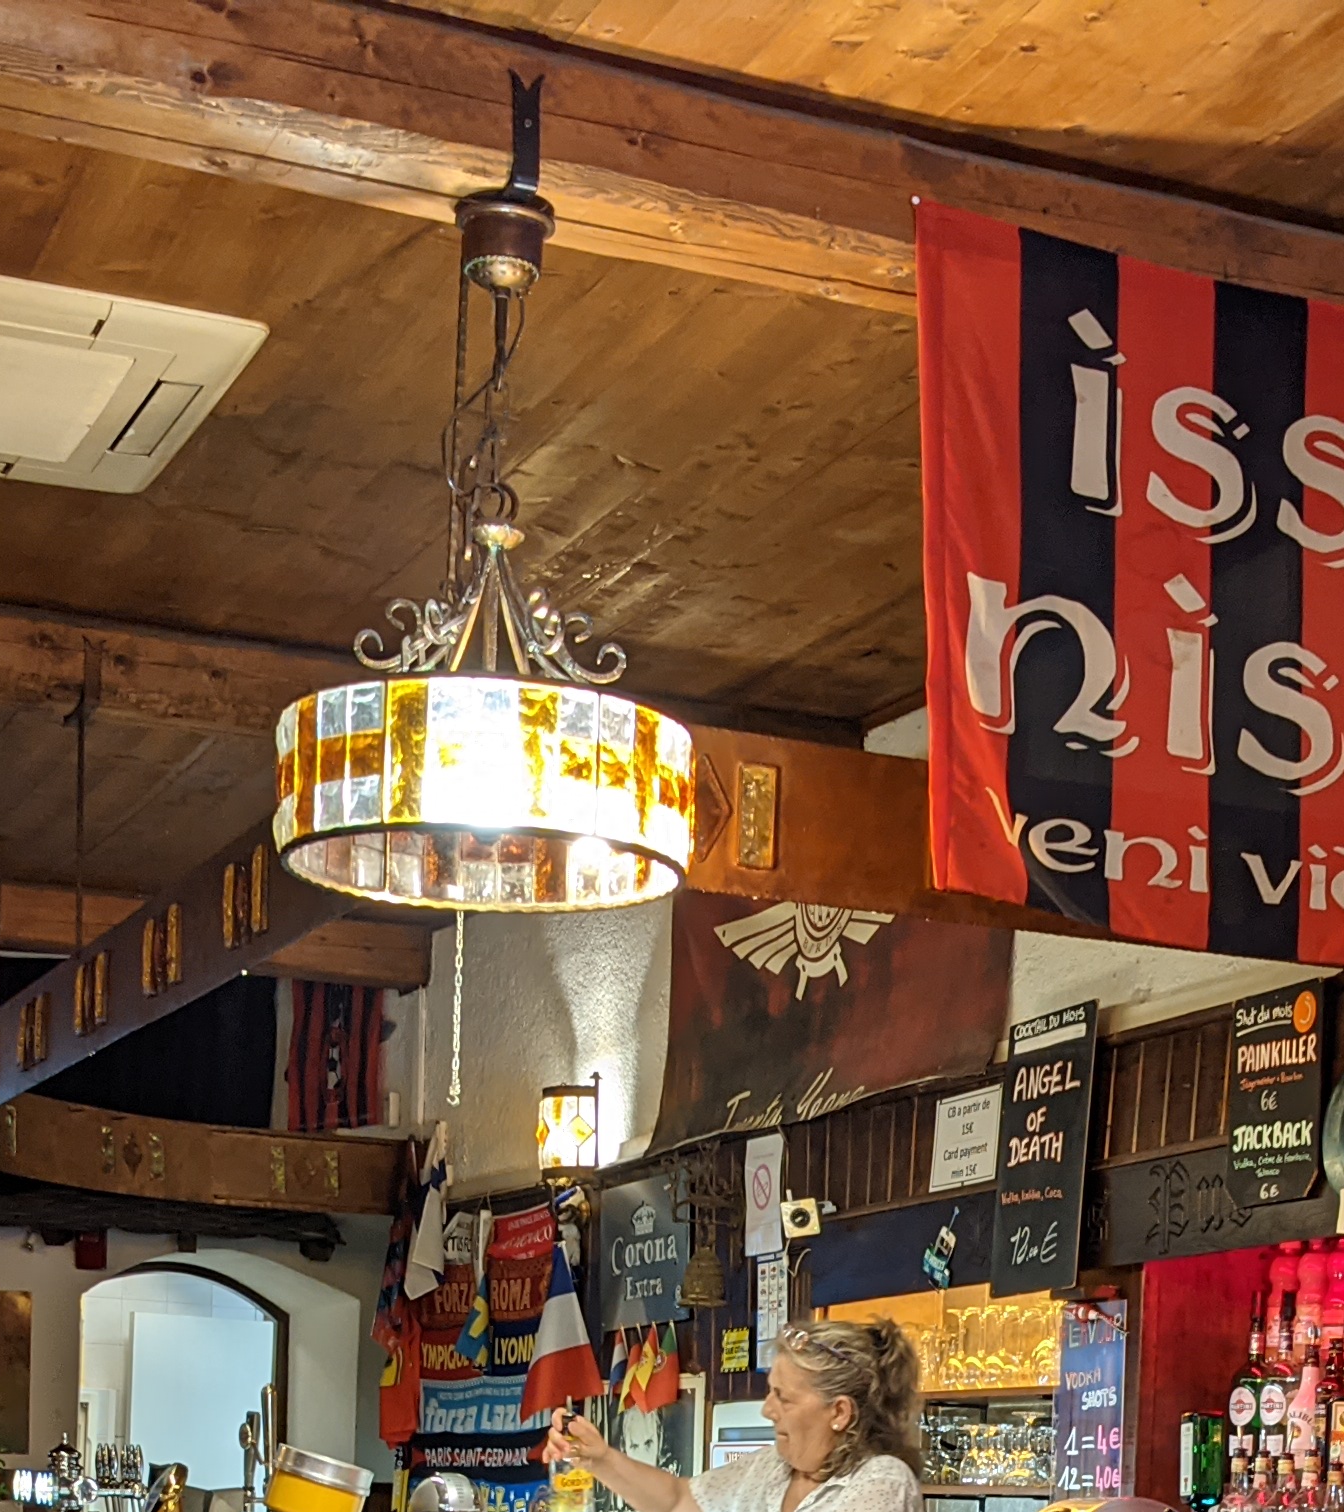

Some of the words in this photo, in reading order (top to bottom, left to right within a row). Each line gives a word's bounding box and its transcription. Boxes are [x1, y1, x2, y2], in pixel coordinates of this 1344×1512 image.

[1049, 1014, 1061, 1030] DU
[1062, 1006, 1086, 1024] MOIS
[1237, 1032, 1318, 1075] PAINKILLER
[1012, 1059, 1082, 1103] ANGEL
[1260, 1089, 1278, 1111] 6€
[1026, 1106, 1048, 1133] OF
[1232, 1119, 1314, 1154] JACKBACK
[943, 1147, 959, 1161] Card
[1007, 1131, 1065, 1168] DEATH
[1259, 1182, 1280, 1200] 6€
[611, 1234, 678, 1276] Corona
[490, 1277, 532, 1312] ROMA
[625, 1276, 663, 1300] Extra
[1065, 1367, 1102, 1391] VODKA
[1081, 1386, 1117, 1411] SHOTS
[424, 1447, 452, 1468] PARIS
